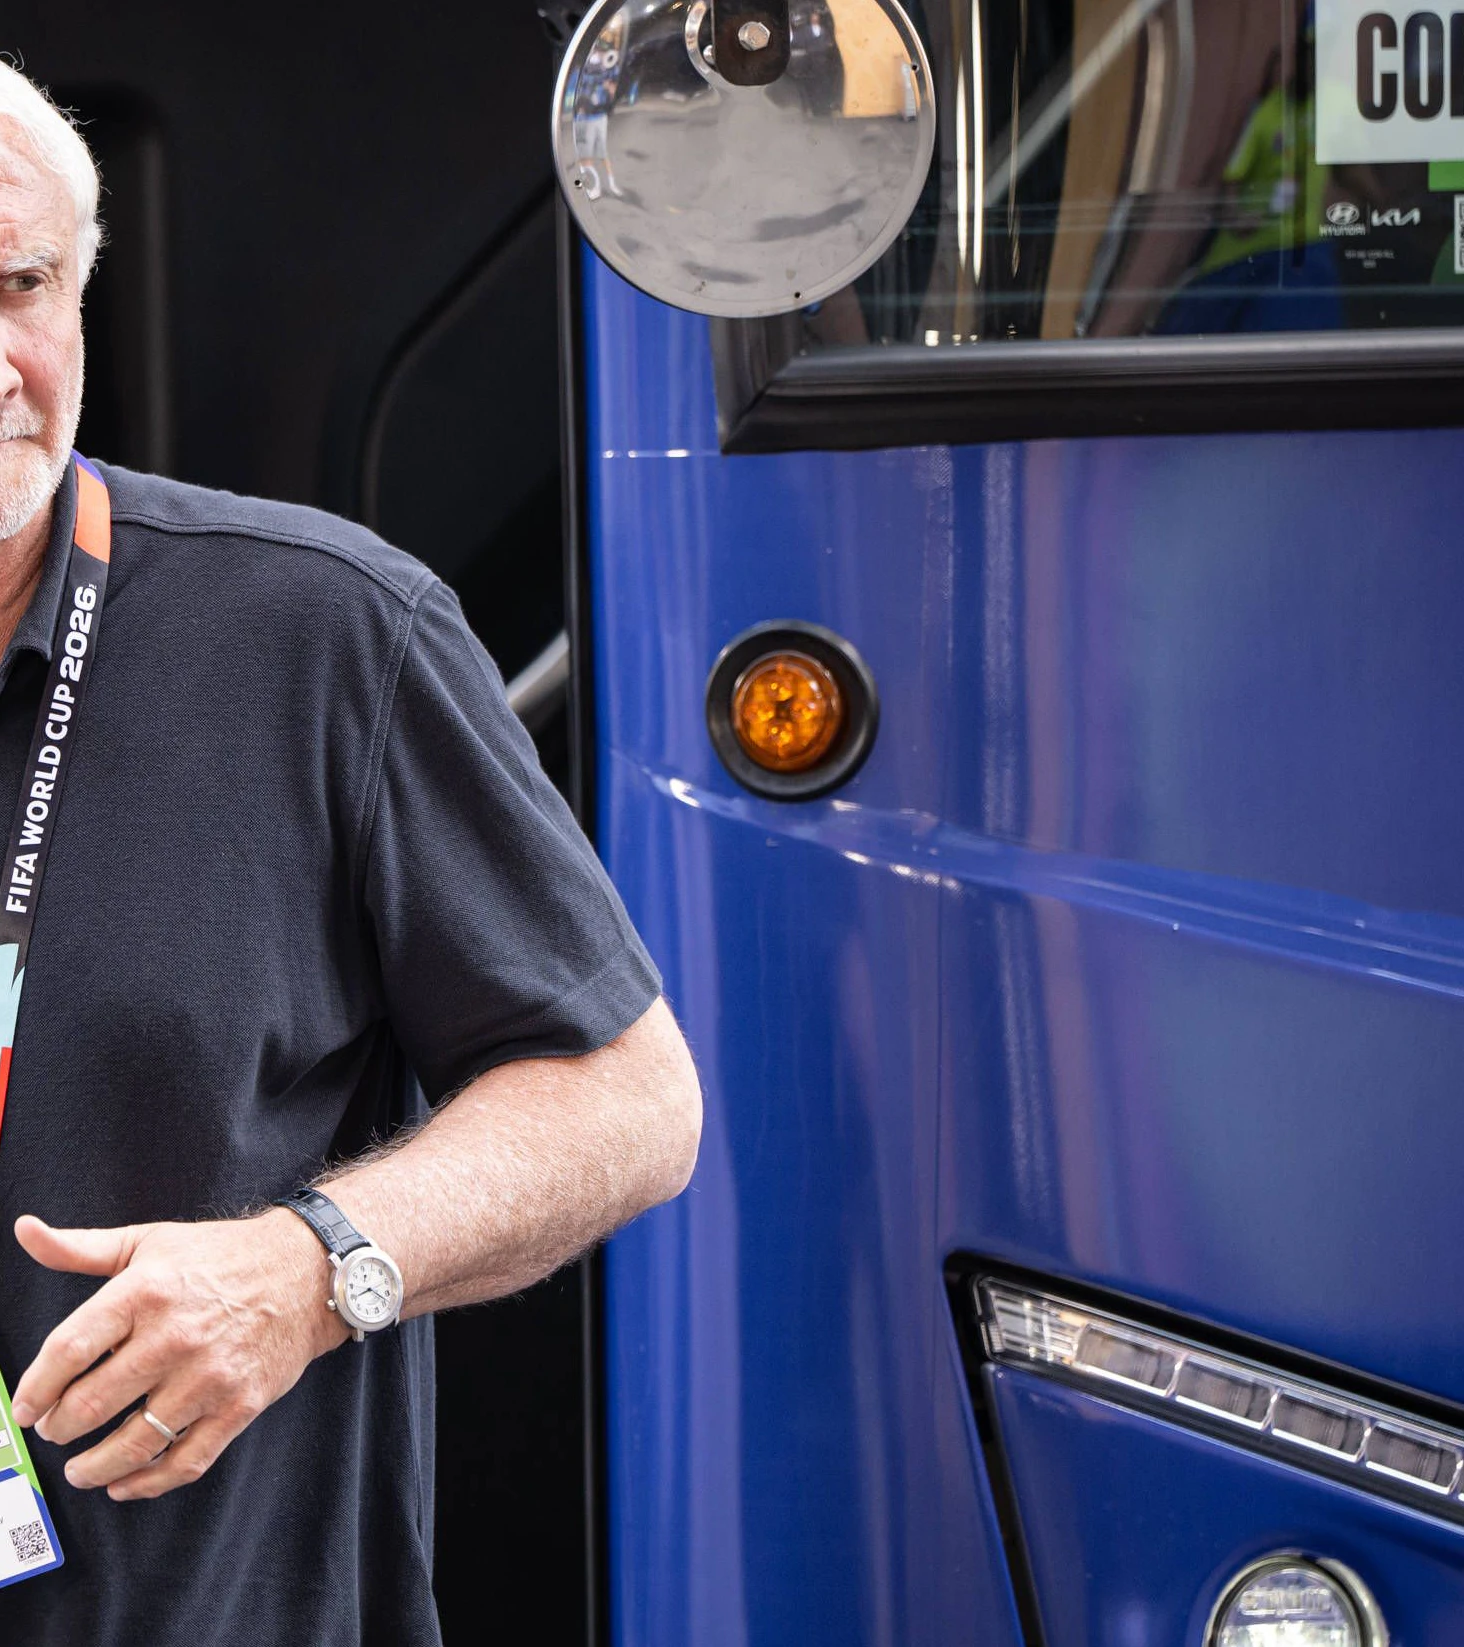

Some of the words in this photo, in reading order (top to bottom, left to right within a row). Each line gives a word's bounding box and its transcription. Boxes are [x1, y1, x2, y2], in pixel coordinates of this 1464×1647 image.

[45, 684, 75, 741] CUP
[19, 745, 62, 847] WORLD
[5, 851, 39, 914] FIFA
